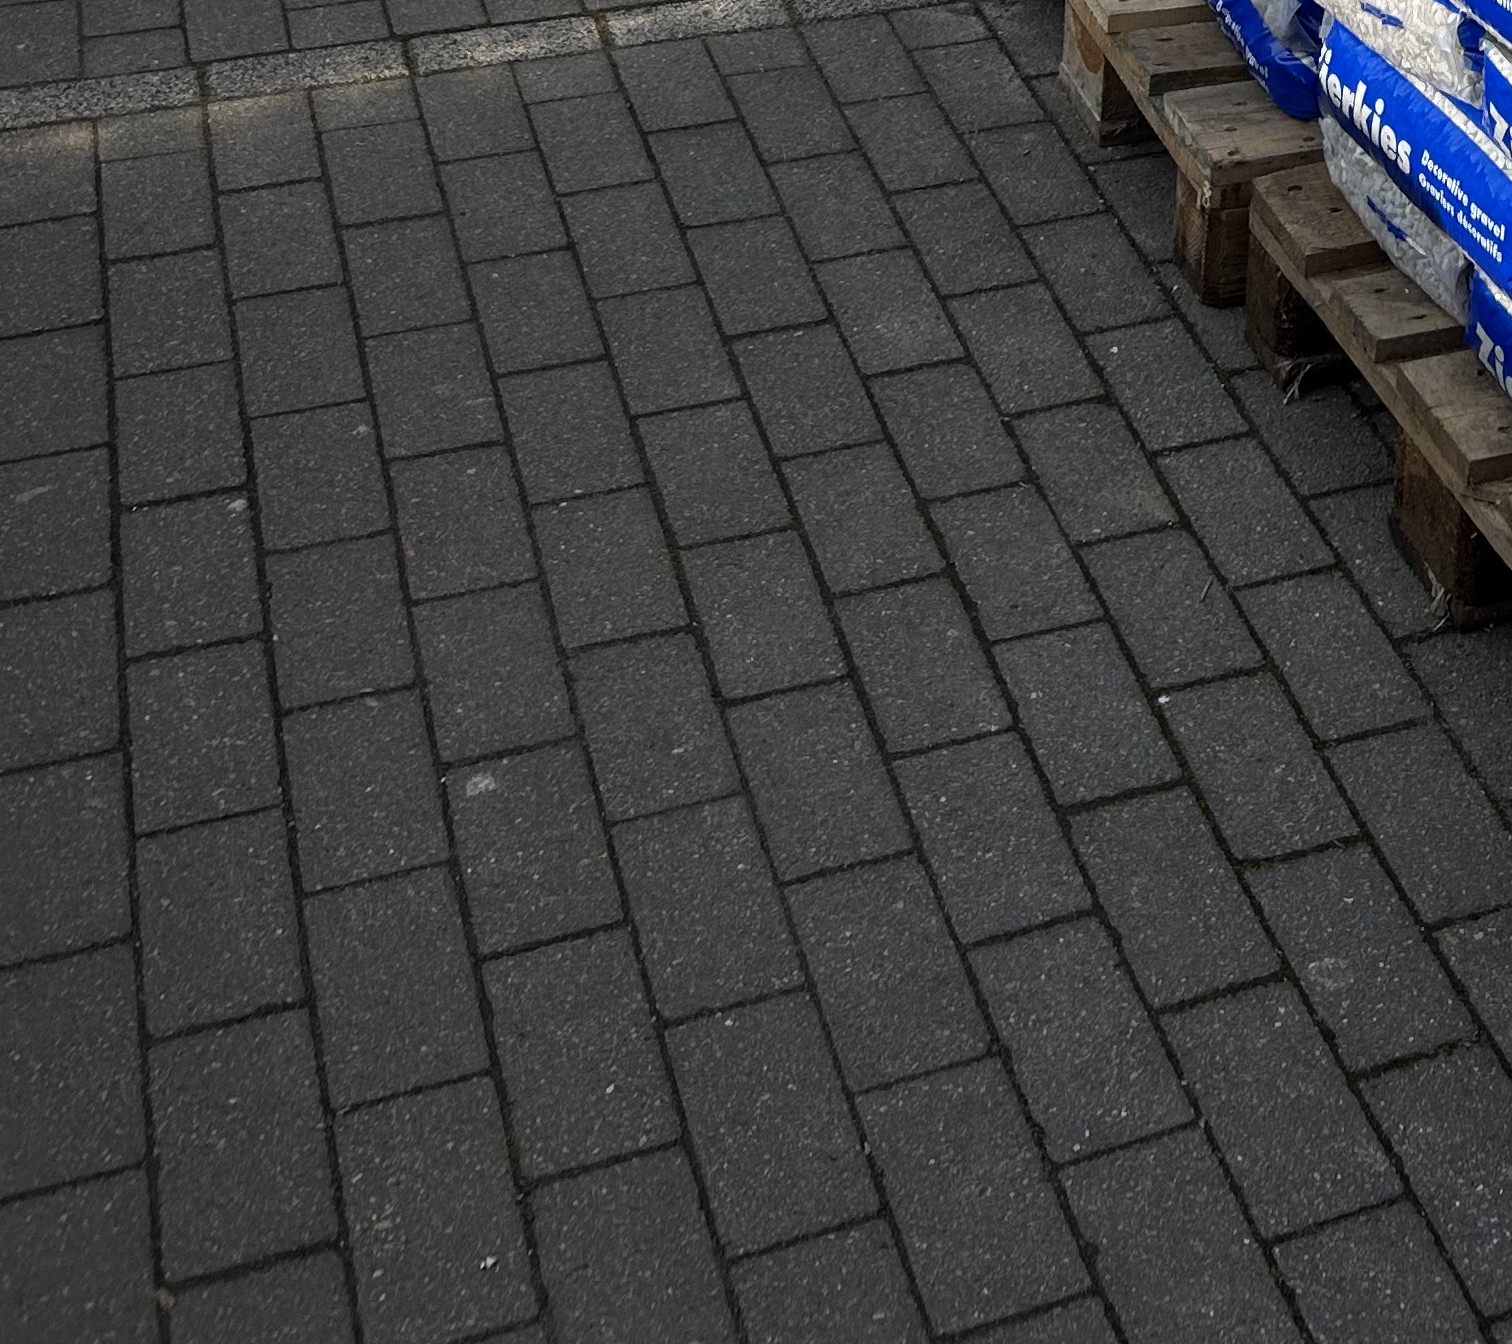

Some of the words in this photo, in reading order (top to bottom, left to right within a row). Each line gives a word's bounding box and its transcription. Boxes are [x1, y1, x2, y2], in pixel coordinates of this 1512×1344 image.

[1418, 172, 1456, 219] Graviers
[1457, 207, 1504, 264] décoratifs
[1420, 148, 1470, 208] Decorative
[1470, 199, 1507, 242] gravel
